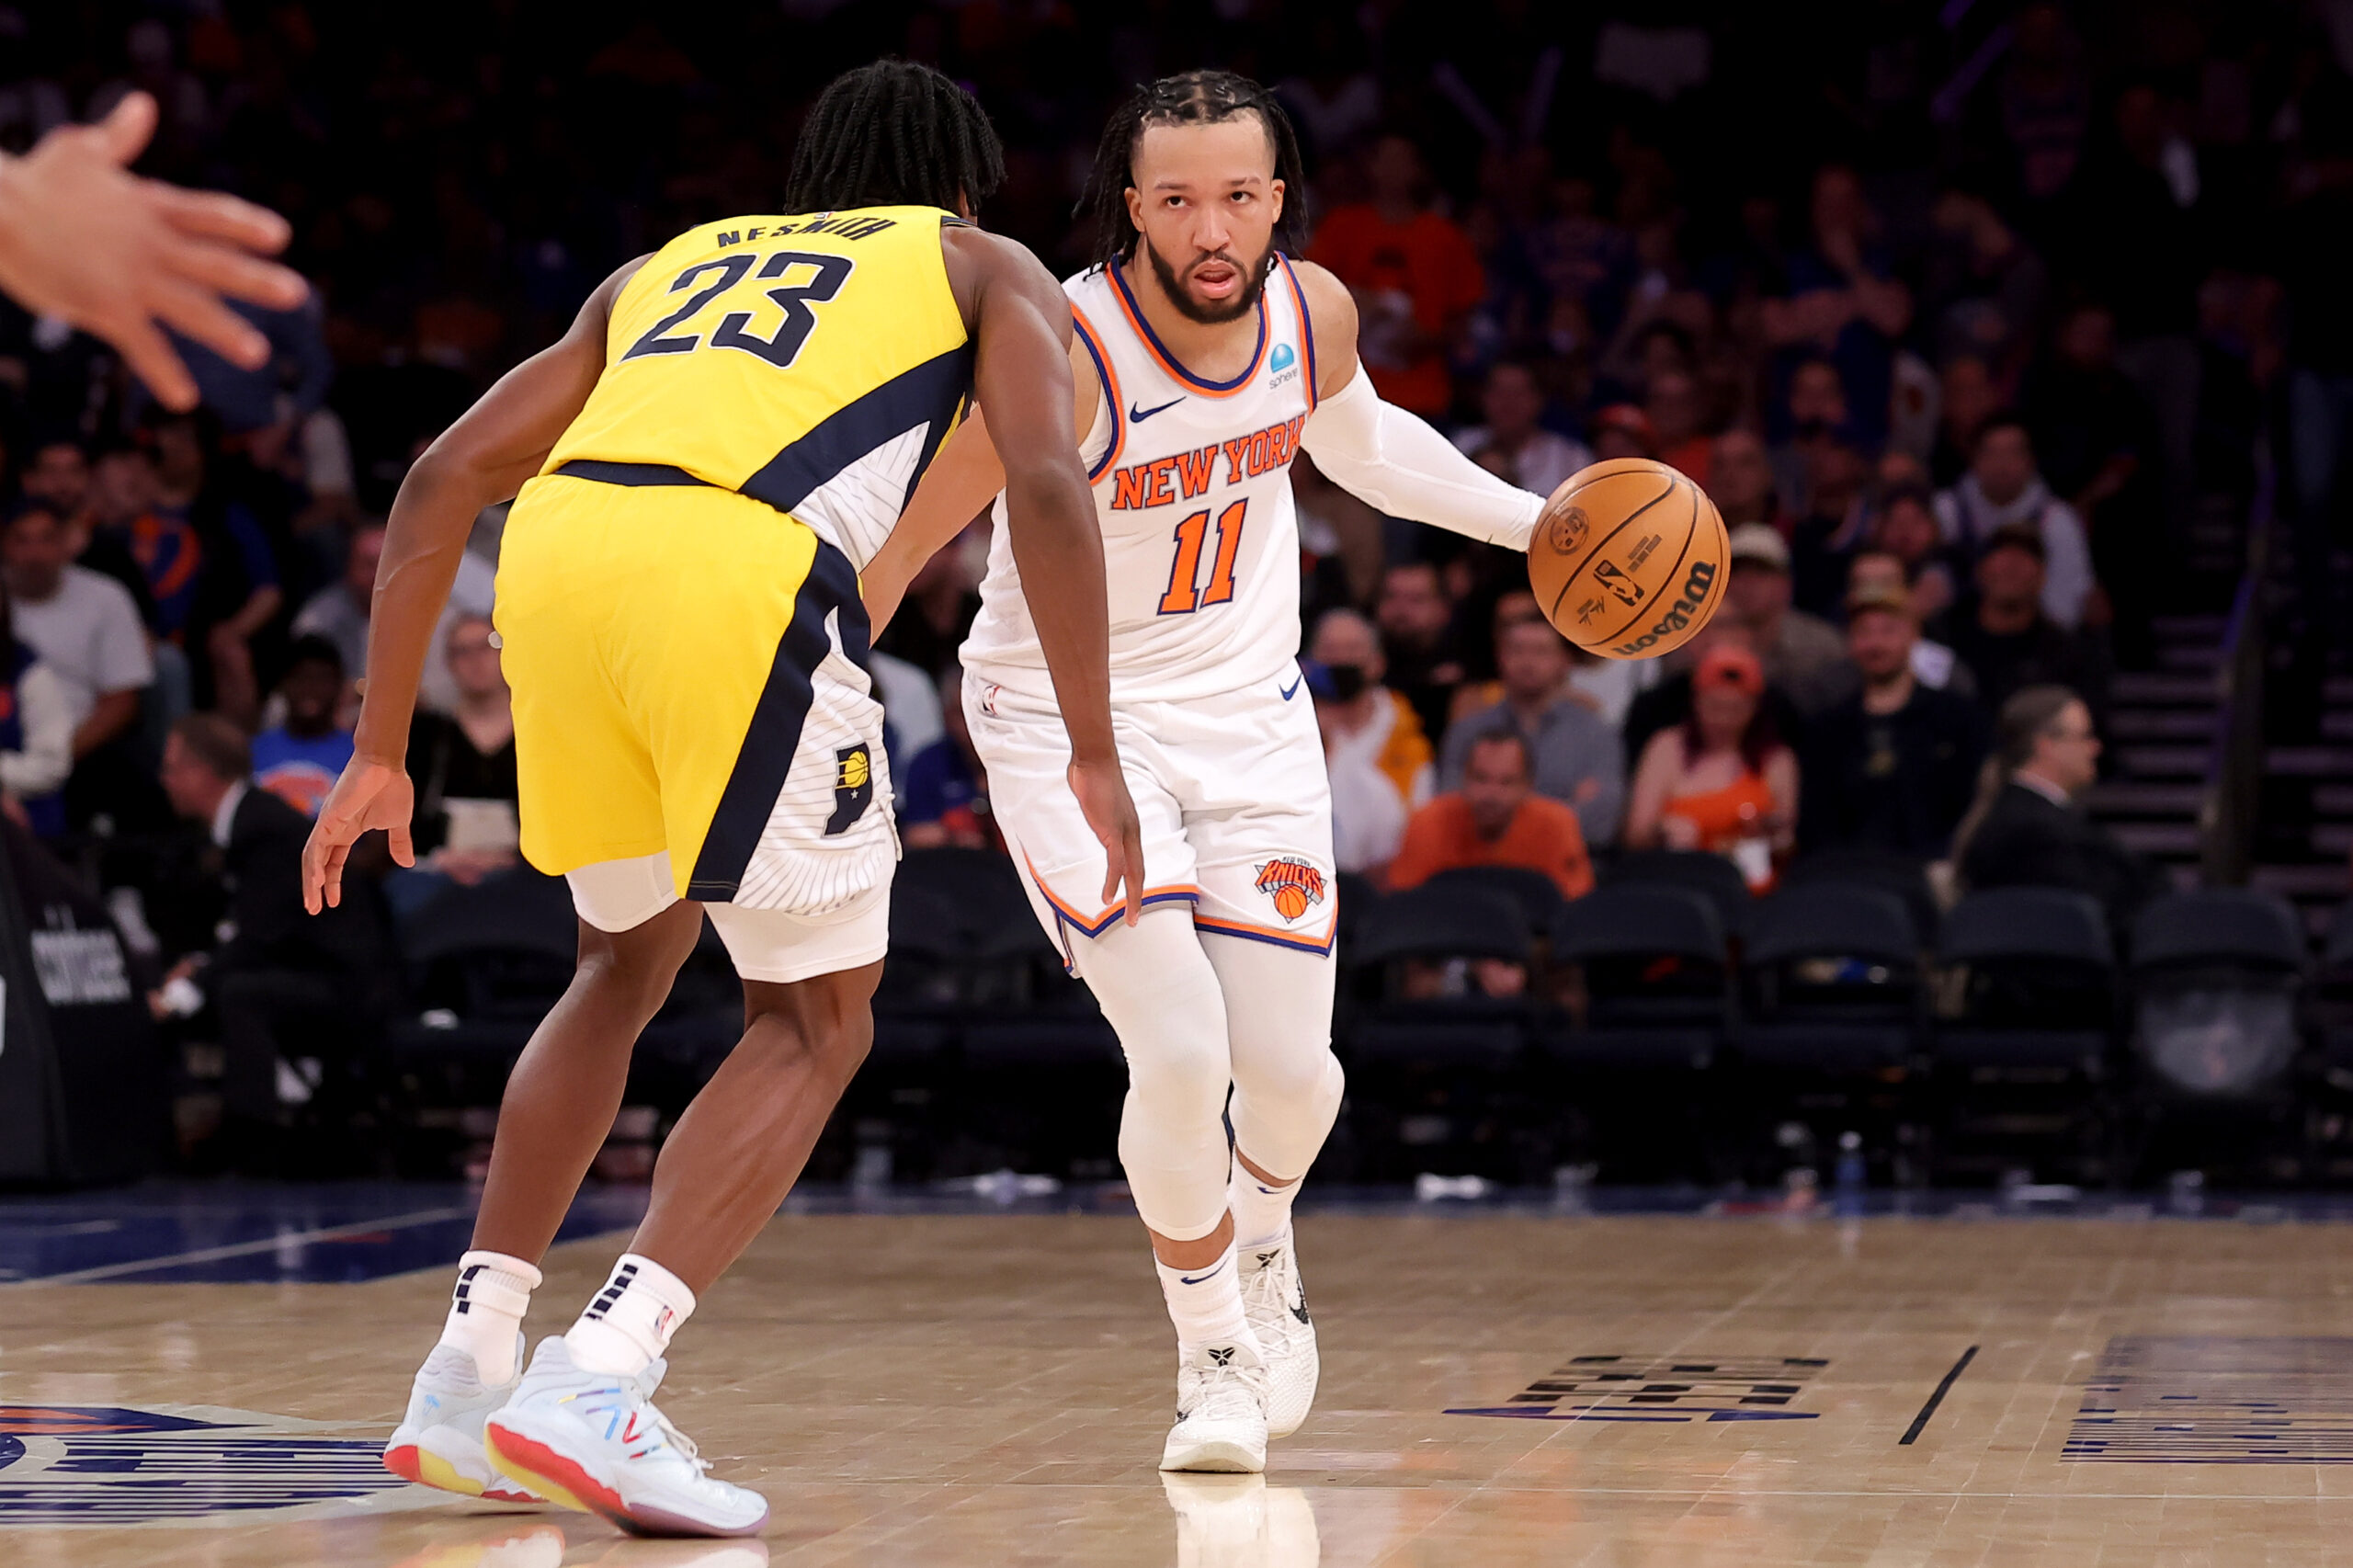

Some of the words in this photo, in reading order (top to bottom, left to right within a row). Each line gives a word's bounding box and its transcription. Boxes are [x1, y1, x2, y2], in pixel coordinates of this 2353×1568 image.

[717, 217, 898, 248] NESMITH
[620, 251, 857, 369] 23
[1110, 444, 1219, 510] NEW
[1223, 413, 1305, 486] YORK
[1156, 496, 1249, 615] 11
[1255, 858, 1324, 901] KNICKS
